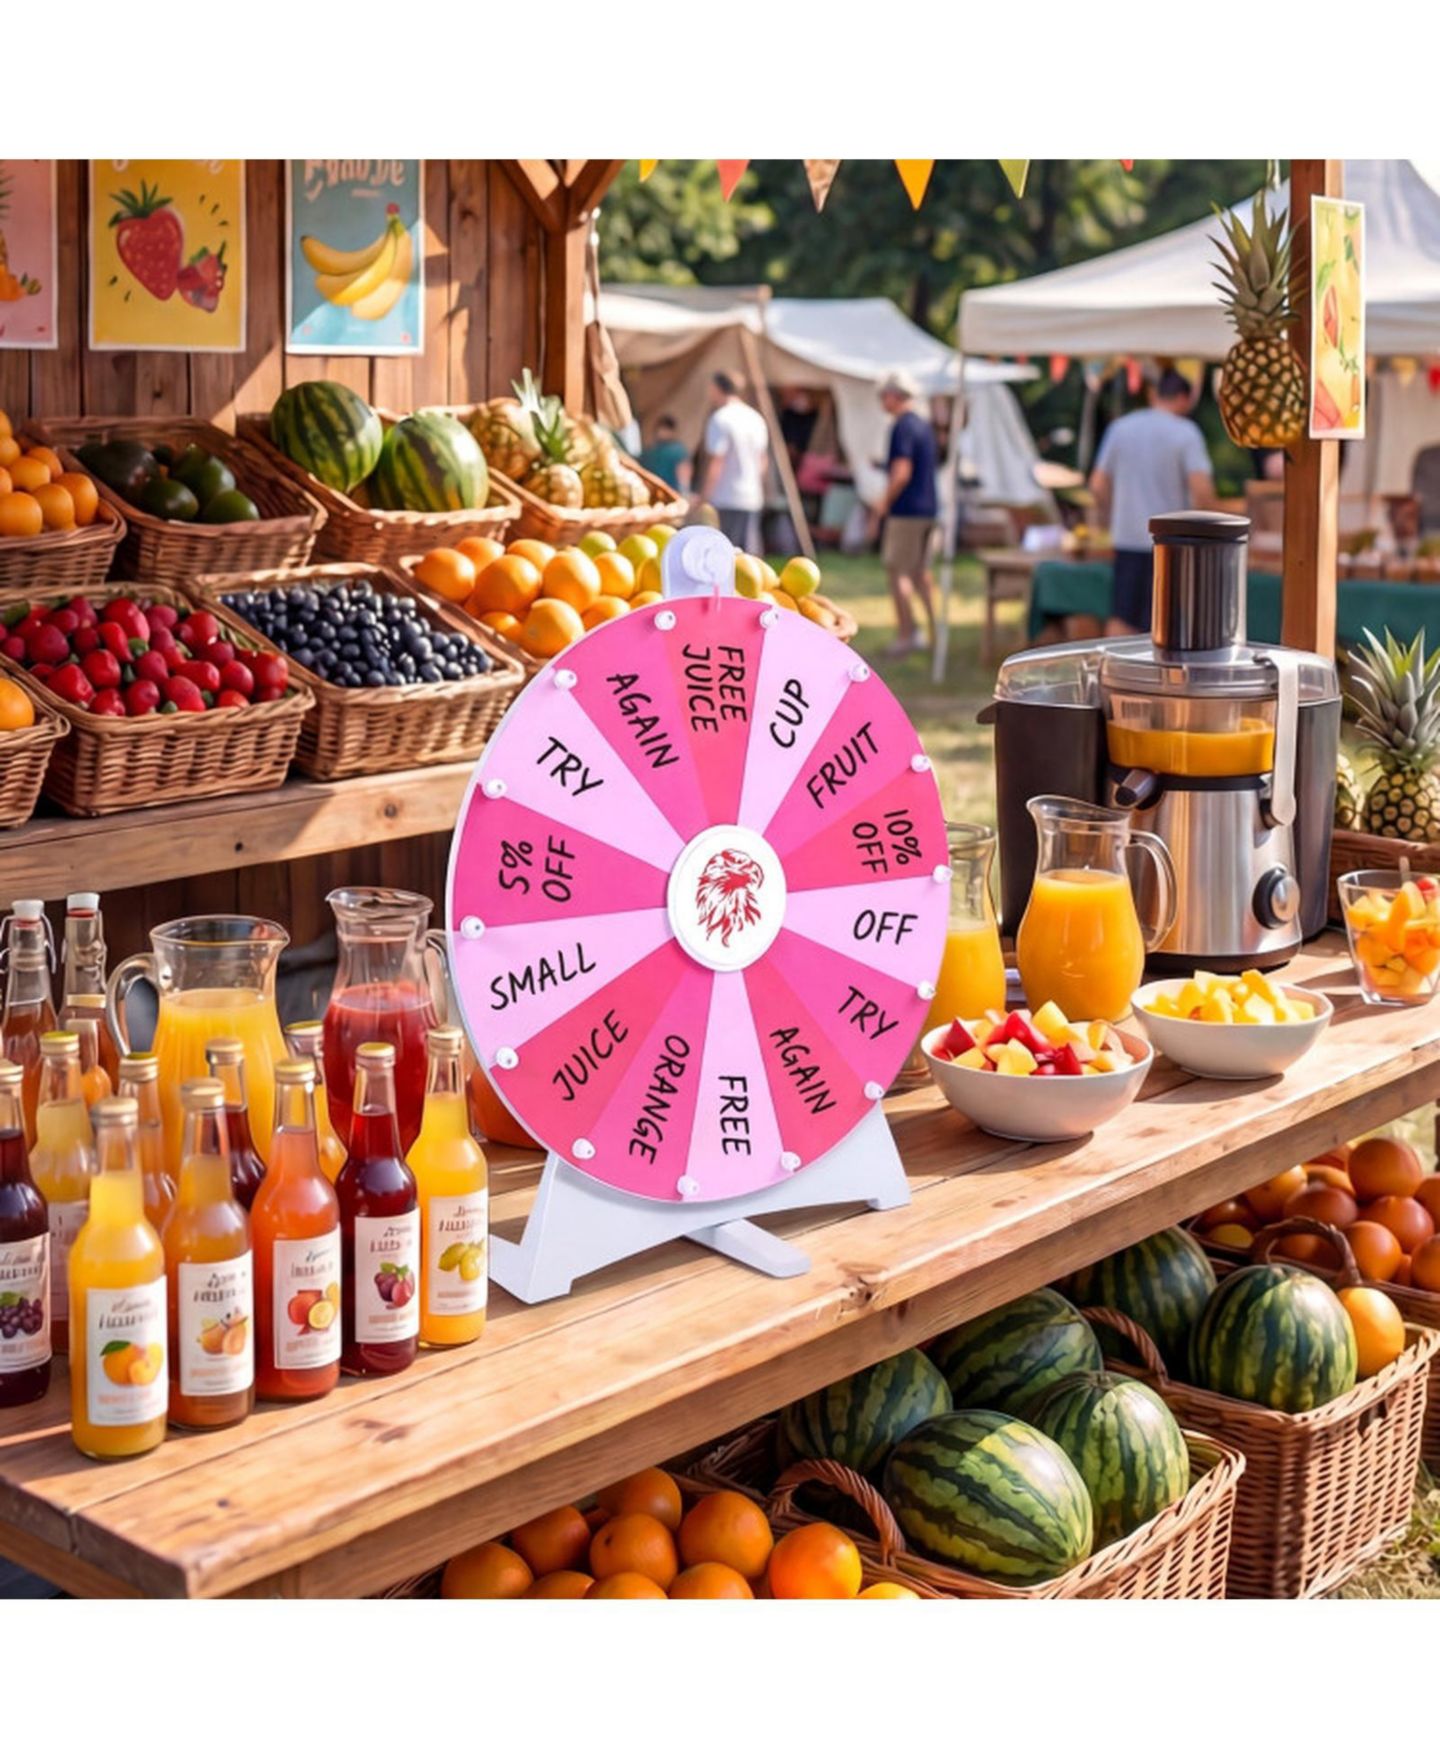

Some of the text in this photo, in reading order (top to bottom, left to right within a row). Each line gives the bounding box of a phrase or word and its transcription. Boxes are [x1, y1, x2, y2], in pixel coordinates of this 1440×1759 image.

[683, 645, 718, 731] JUICE
[717, 647, 746, 726] FREE
[770, 679, 809, 748] CUP
[607, 675, 678, 768] AGAIN
[537, 737, 603, 796] TRY
[807, 722, 877, 808] FRUIT
[499, 841, 532, 893] 5%
[542, 836, 574, 902] OFF
[853, 822, 888, 874] OFF
[884, 810, 921, 867] 10%
[854, 910, 917, 944] OFF
[491, 943, 595, 1010] SMALL
[839, 986, 898, 1039] TRY
[553, 1011, 628, 1100] JUICE
[771, 1028, 835, 1113] AGAIN
[628, 1034, 690, 1164] ORANGE
[719, 1076, 751, 1154] FREE
